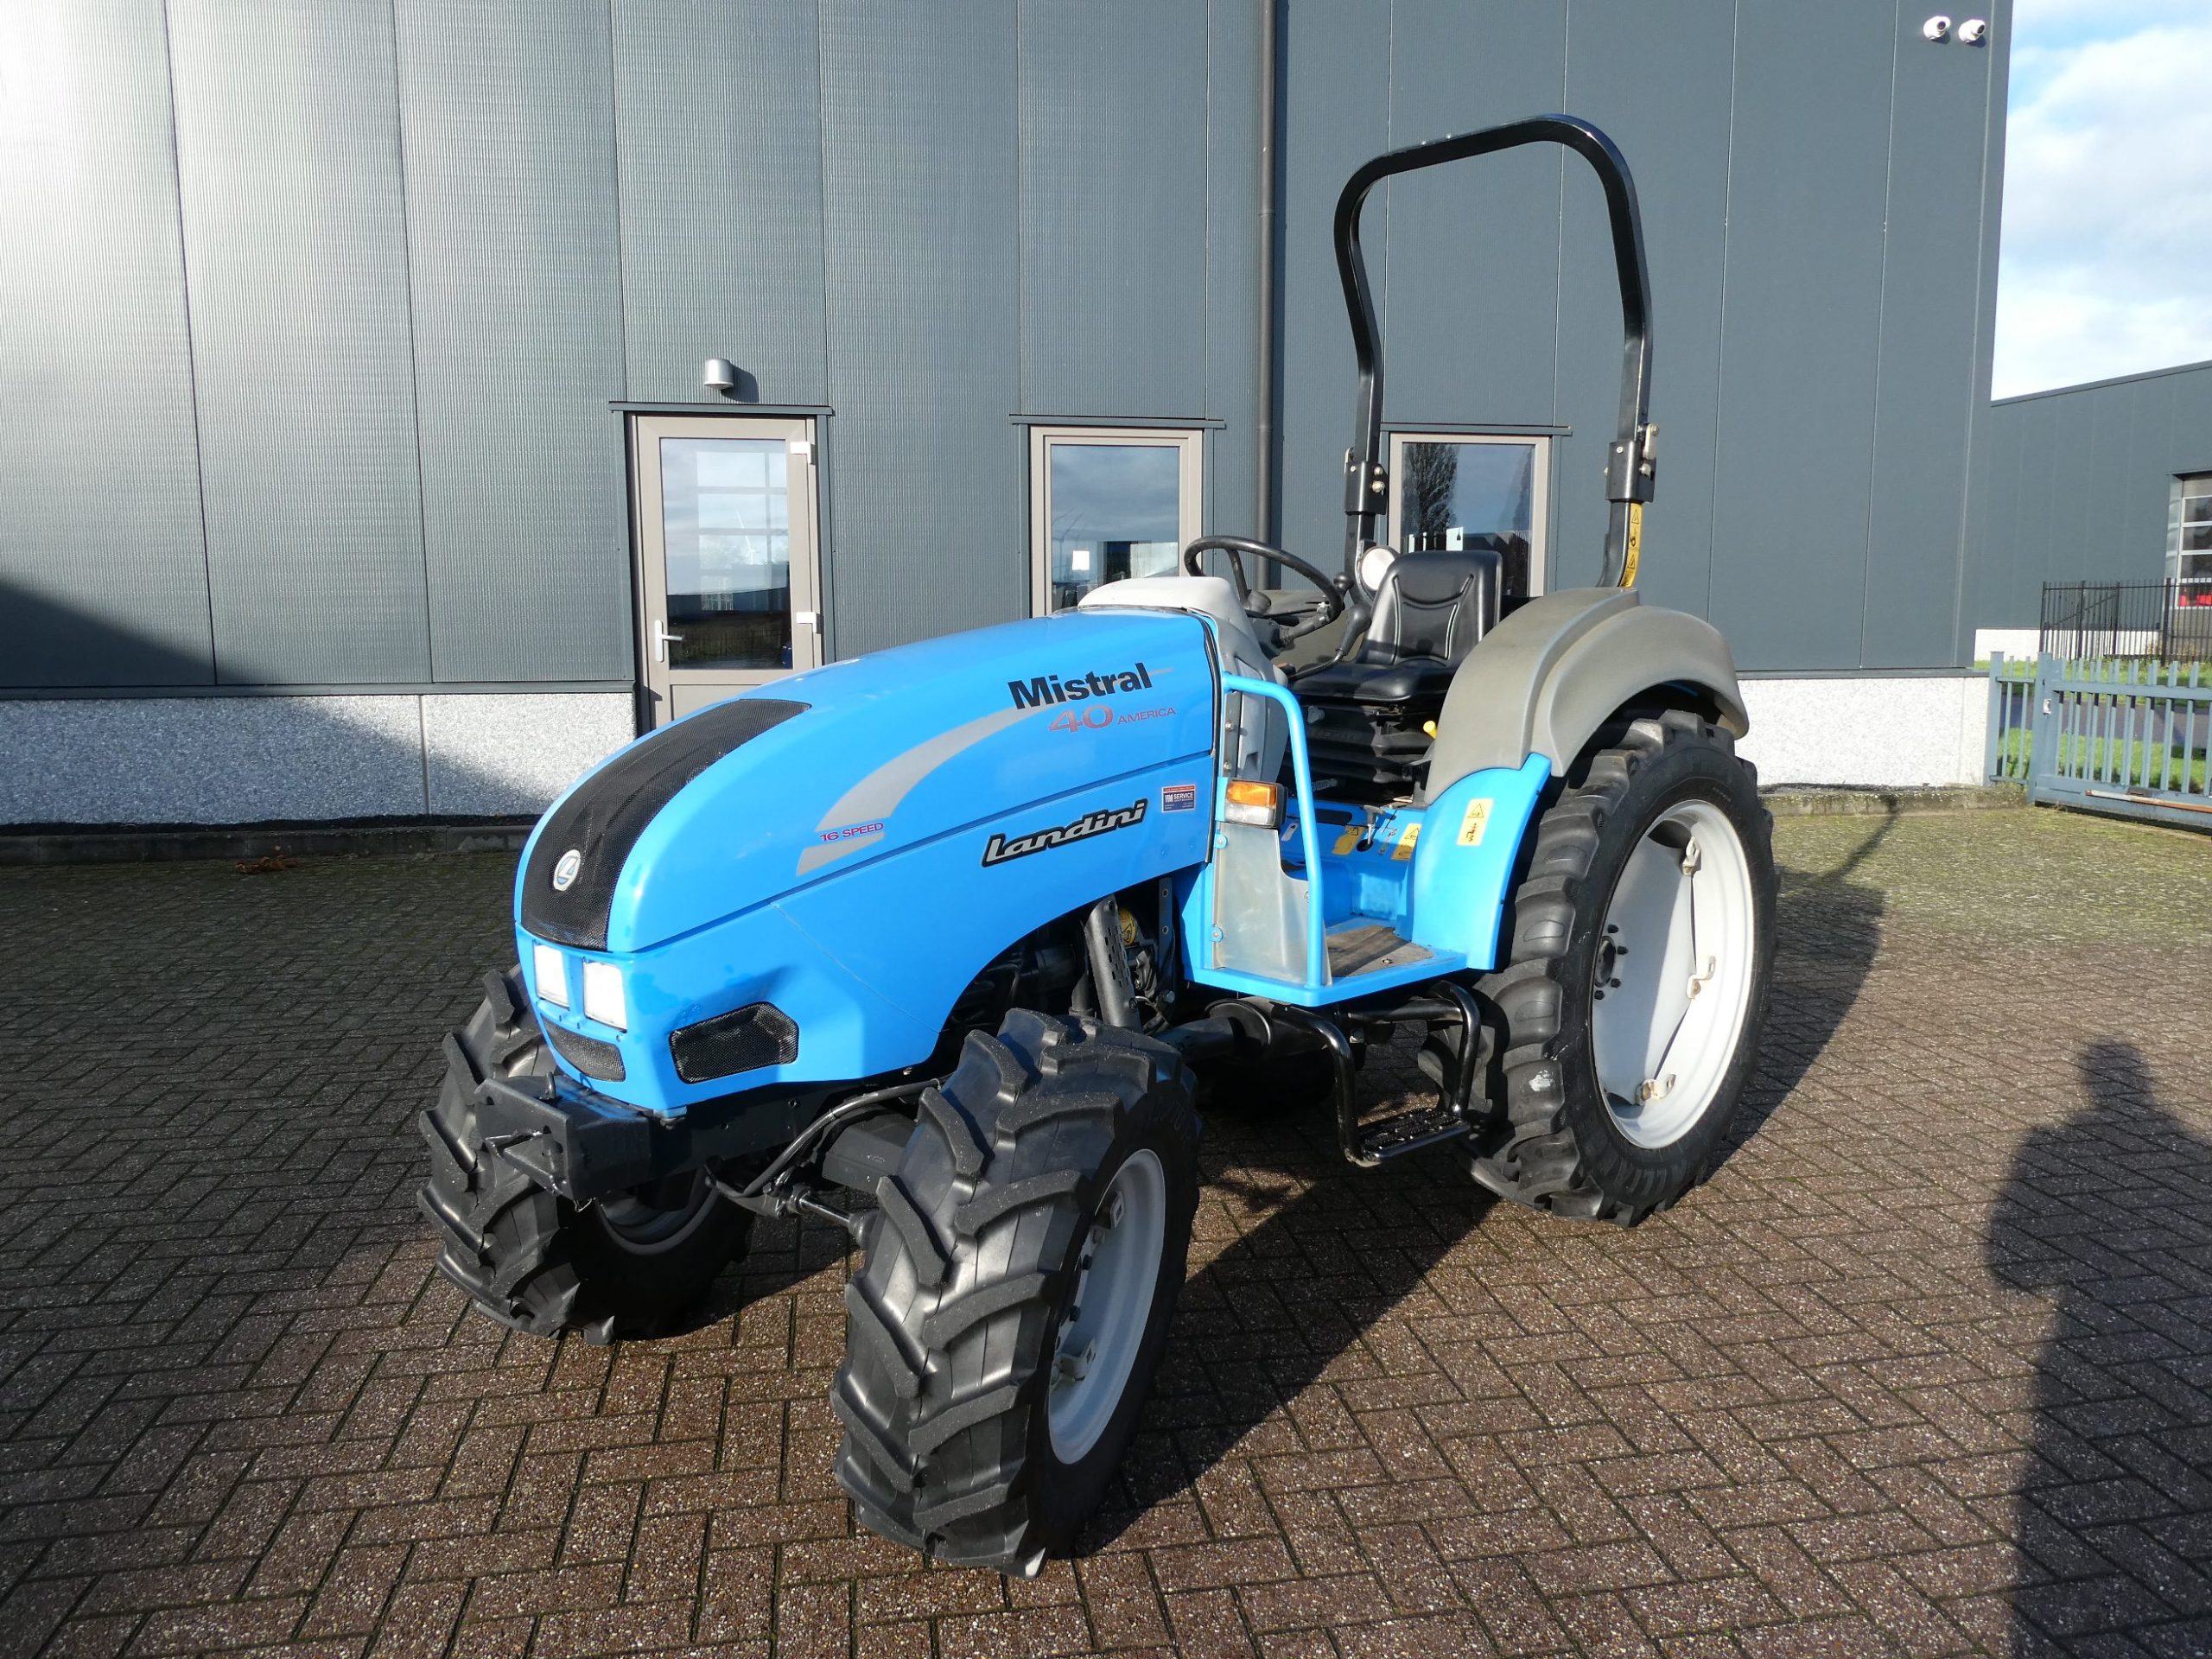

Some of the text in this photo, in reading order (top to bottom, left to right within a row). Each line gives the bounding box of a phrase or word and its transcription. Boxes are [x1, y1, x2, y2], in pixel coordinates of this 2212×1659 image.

[1007, 662, 1153, 710] Mistral
[1048, 704, 1176, 733] 40 AMERICA
[819, 823, 884, 842] 16 SPEED
[982, 799, 1147, 866] Landini
